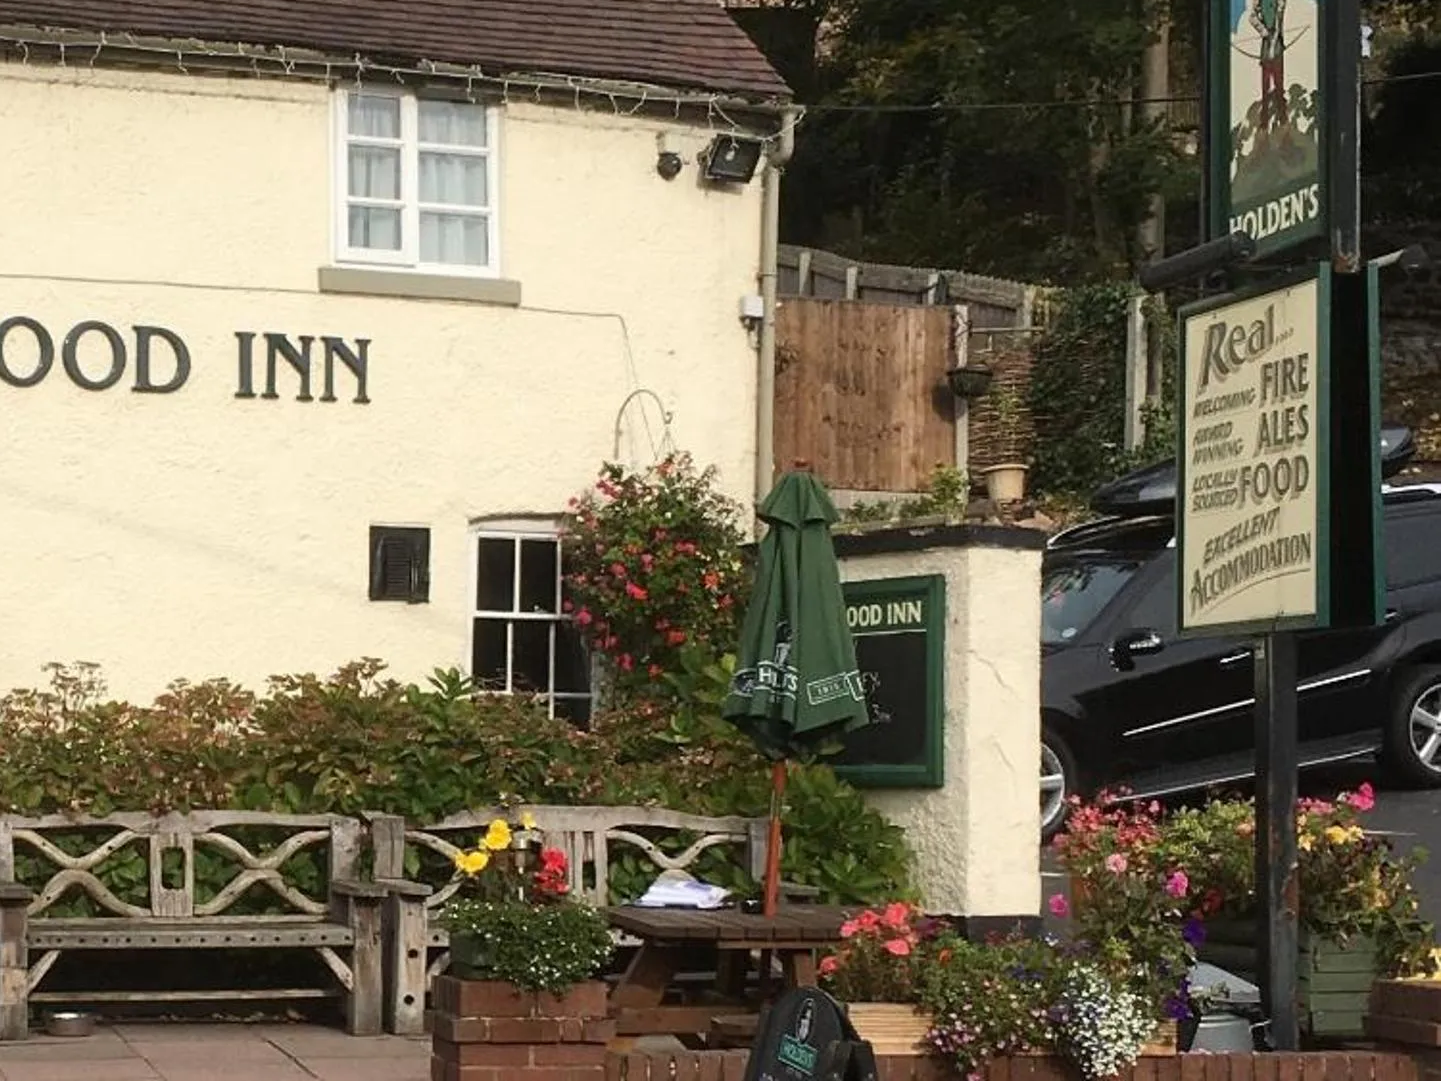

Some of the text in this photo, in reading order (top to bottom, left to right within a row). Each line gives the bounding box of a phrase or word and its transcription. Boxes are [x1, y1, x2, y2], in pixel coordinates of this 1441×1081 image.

[1229, 183, 1319, 240] HOLDEN'S
[234, 331, 371, 404] INN
[1193, 353, 1309, 418] WELCOMING FIRE
[1258, 404, 1309, 452] ALES
[1241, 455, 1309, 504] FOOD
[1203, 506, 1280, 566] EXCELLENT
[1191, 531, 1311, 616] ACCOMMODATION
[846, 600, 922, 627] OOD INN
